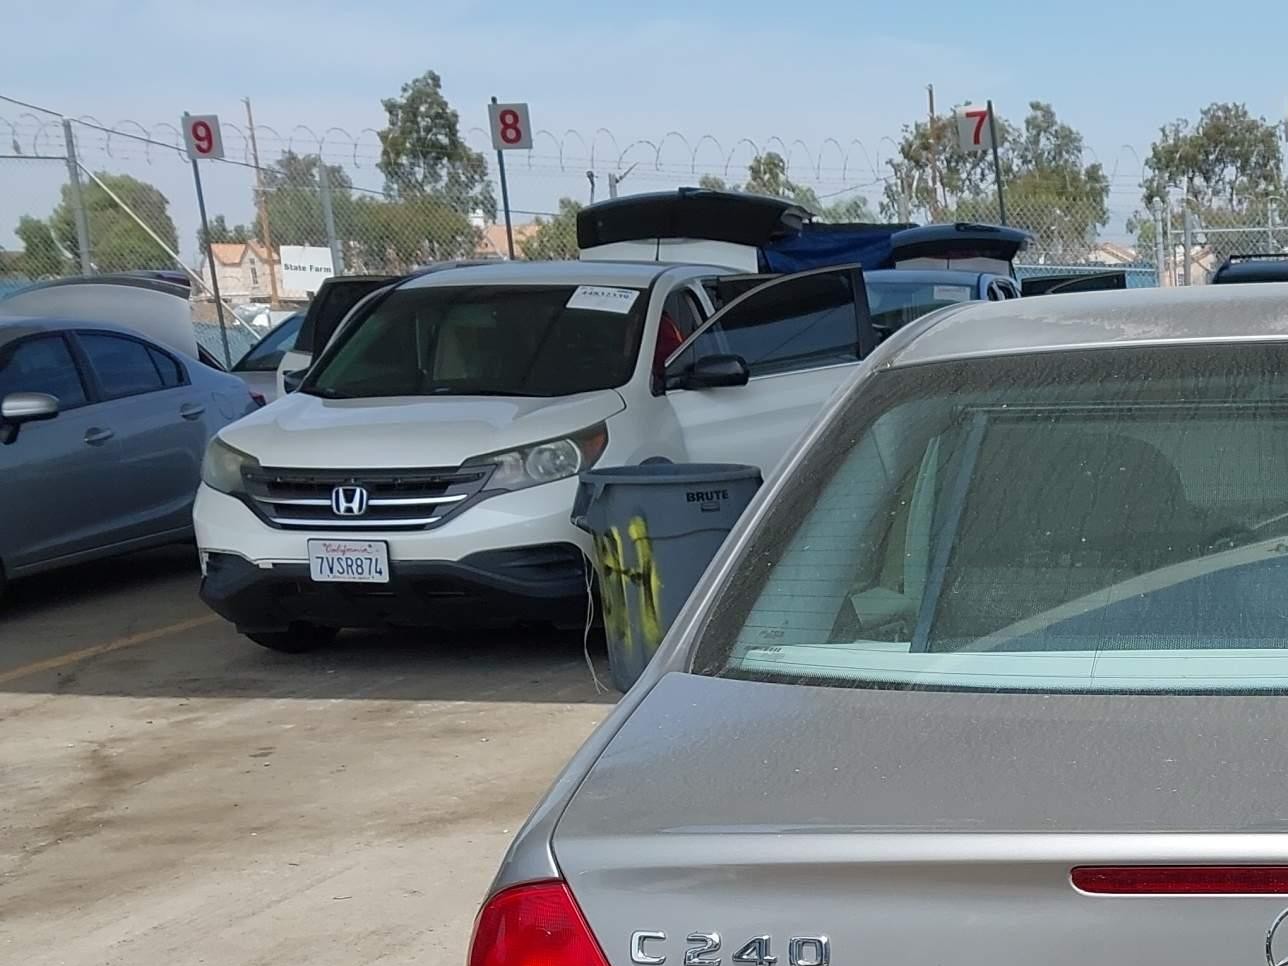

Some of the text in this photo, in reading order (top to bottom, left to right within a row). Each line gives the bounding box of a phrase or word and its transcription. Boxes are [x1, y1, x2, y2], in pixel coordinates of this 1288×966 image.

[190, 120, 214, 154] 9
[500, 109, 521, 144] 8
[966, 110, 987, 145] 7
[284, 263, 332, 273] State Farm
[686, 489, 729, 502] BRUTE
[325, 543, 368, 555] California
[315, 556, 383, 576] 7VSR874
[630, 929, 666, 965] C
